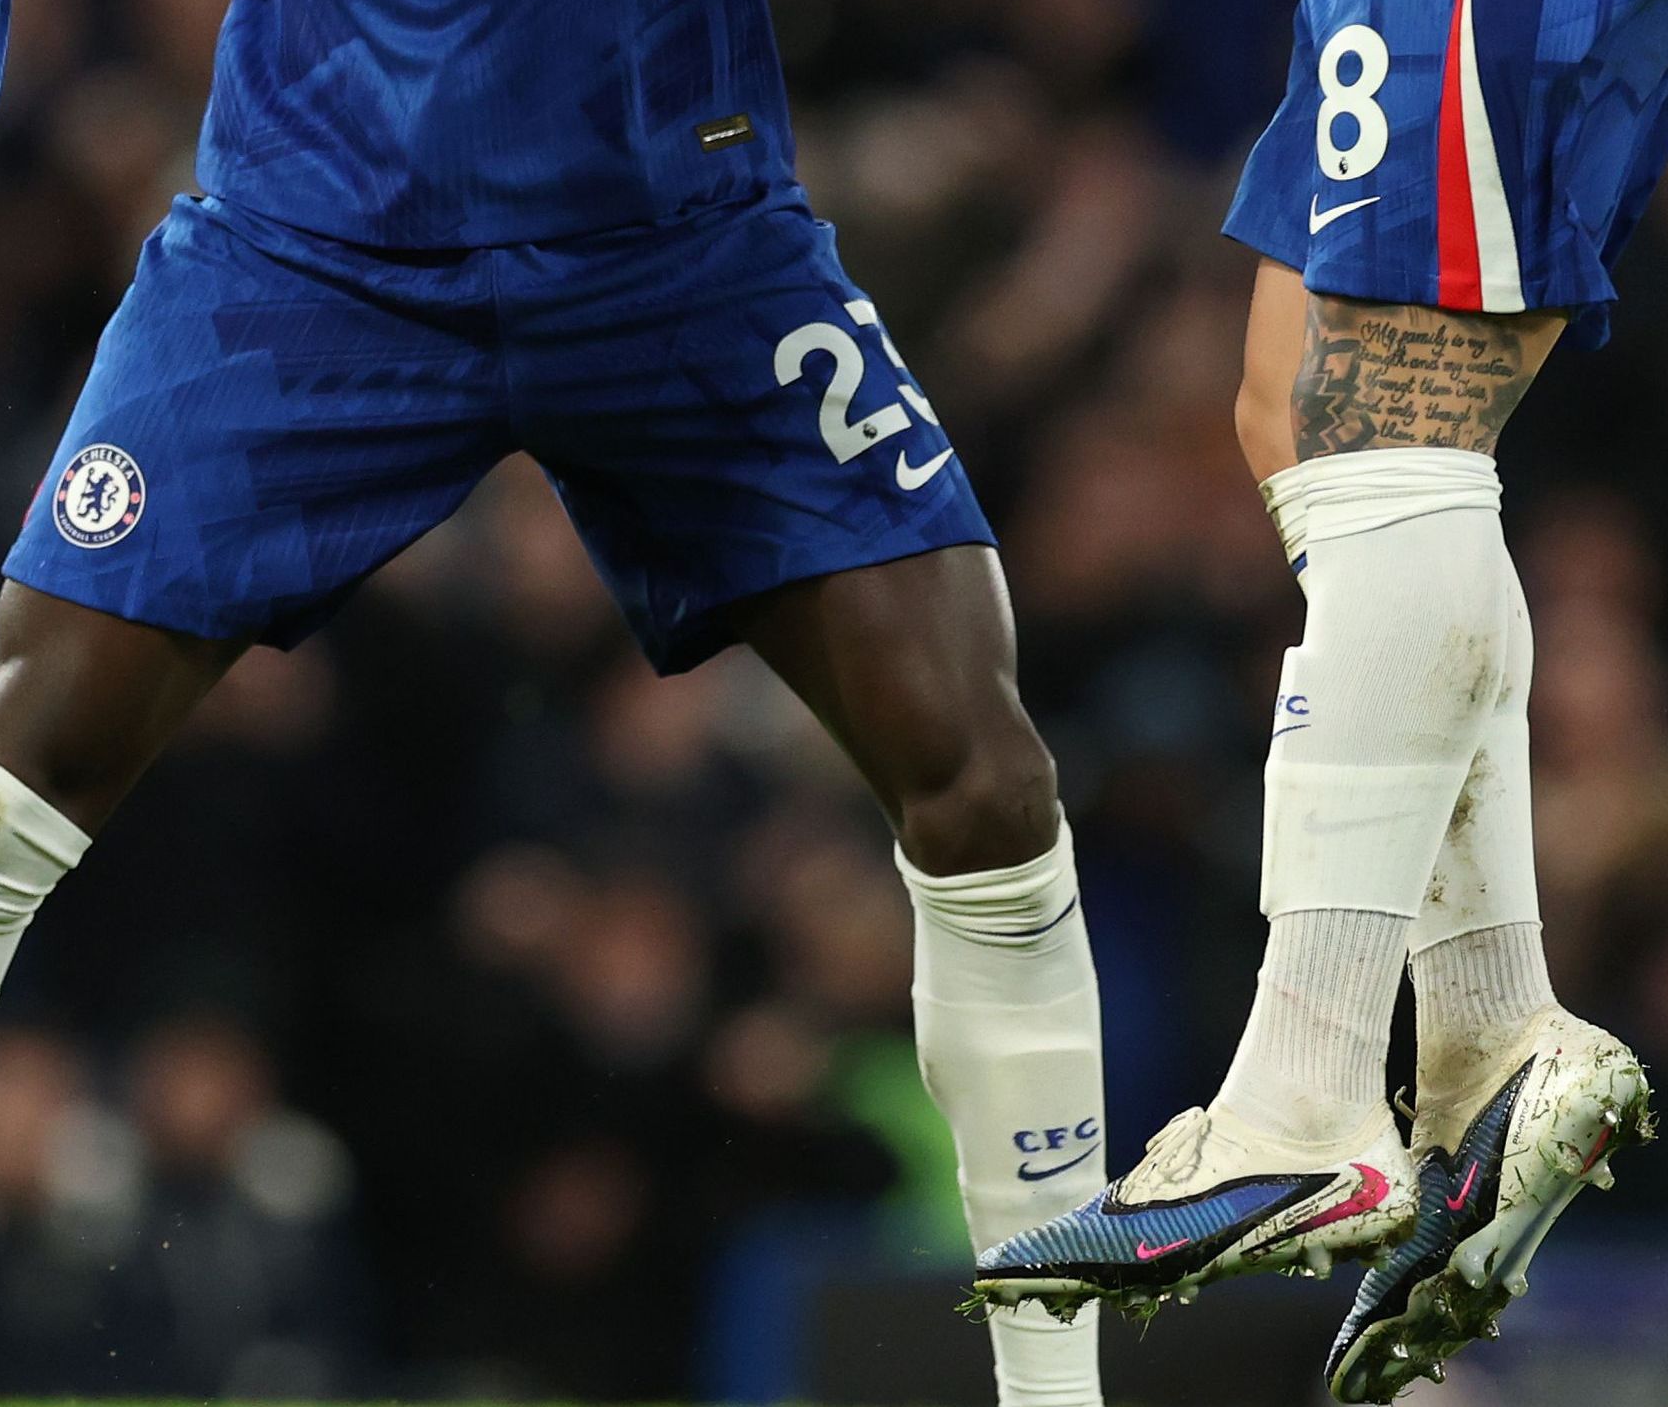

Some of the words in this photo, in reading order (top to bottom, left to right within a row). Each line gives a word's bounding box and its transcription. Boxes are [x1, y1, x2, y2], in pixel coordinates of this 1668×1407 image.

[1315, 23, 1390, 181] 8
[80, 448, 136, 481] CHELSEA
[1013, 1116, 1100, 1153] CFC
